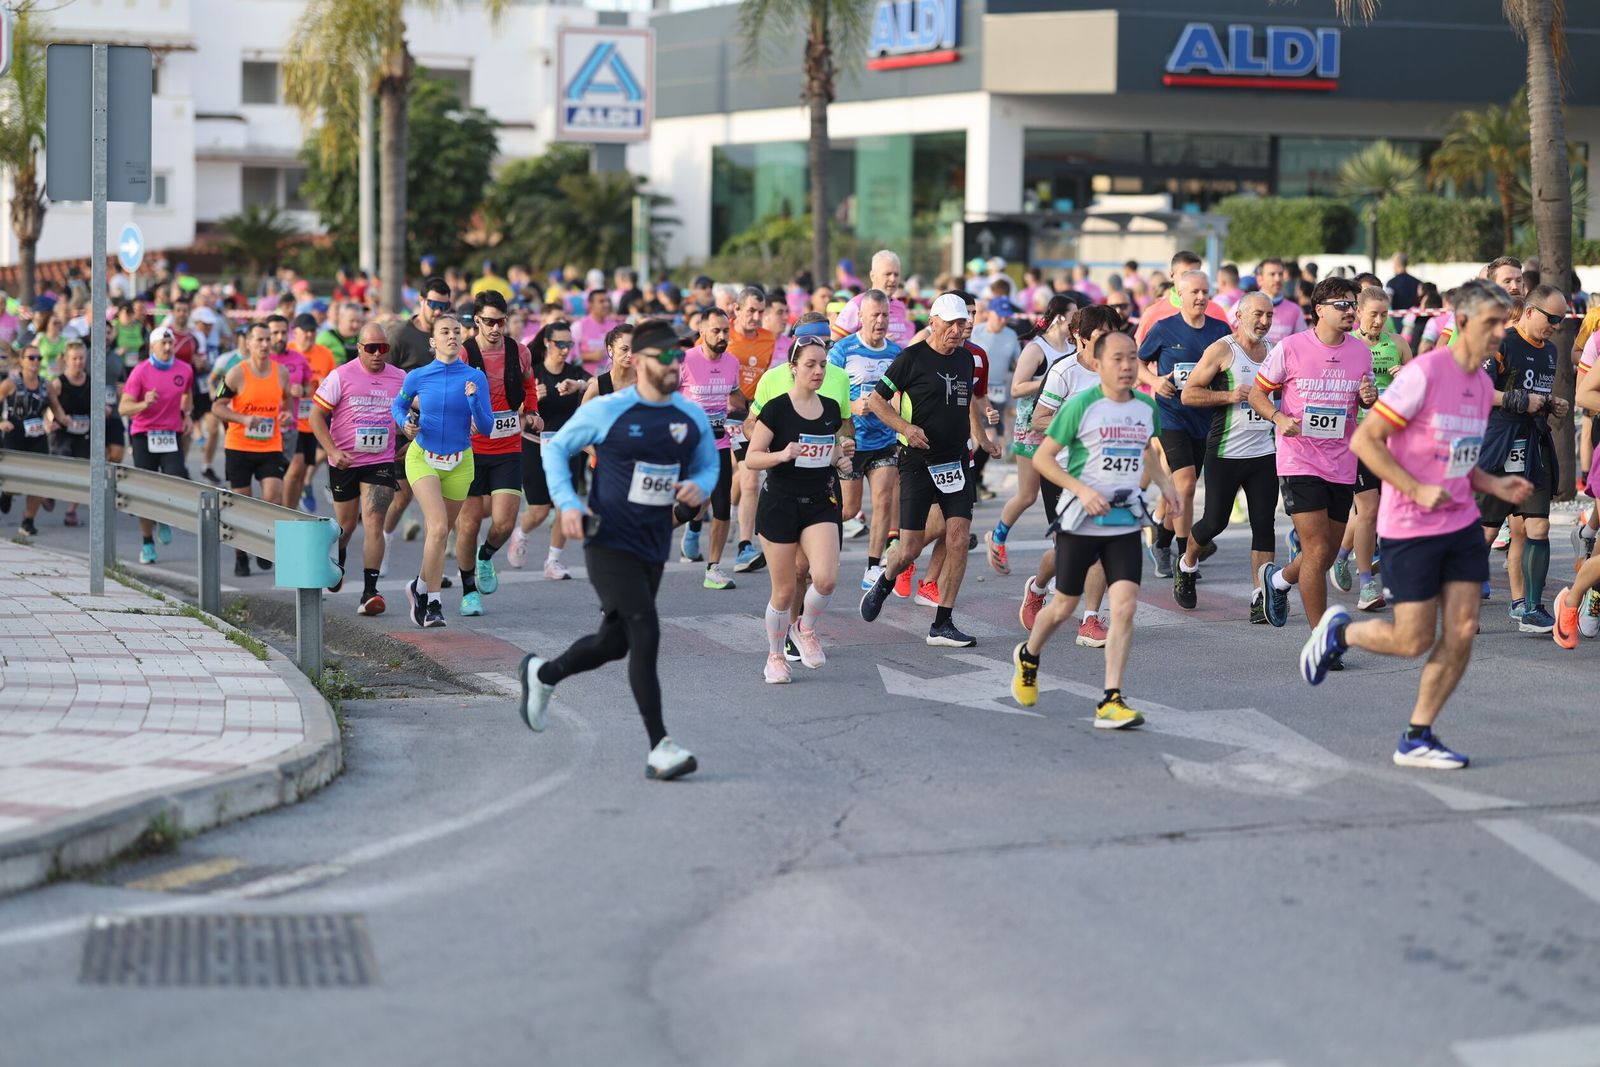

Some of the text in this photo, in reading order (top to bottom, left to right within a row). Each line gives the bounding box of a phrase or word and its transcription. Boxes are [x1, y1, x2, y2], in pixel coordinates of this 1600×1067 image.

[866, 0, 955, 57] ALDI
[1166, 22, 1341, 78] ALDI
[567, 106, 638, 128] ALDI
[1321, 368, 1346, 379] XXXVI
[1523, 369, 1534, 390] 8
[1296, 378, 1324, 391] MEDIA
[495, 417, 517, 430] 842
[1309, 414, 1338, 428] 501
[1099, 426, 1120, 438] VIII
[362, 435, 384, 445] 111
[800, 444, 833, 457] 2317
[1102, 457, 1139, 472] 2475
[642, 476, 673, 492] 966
[934, 470, 963, 485] 2354
